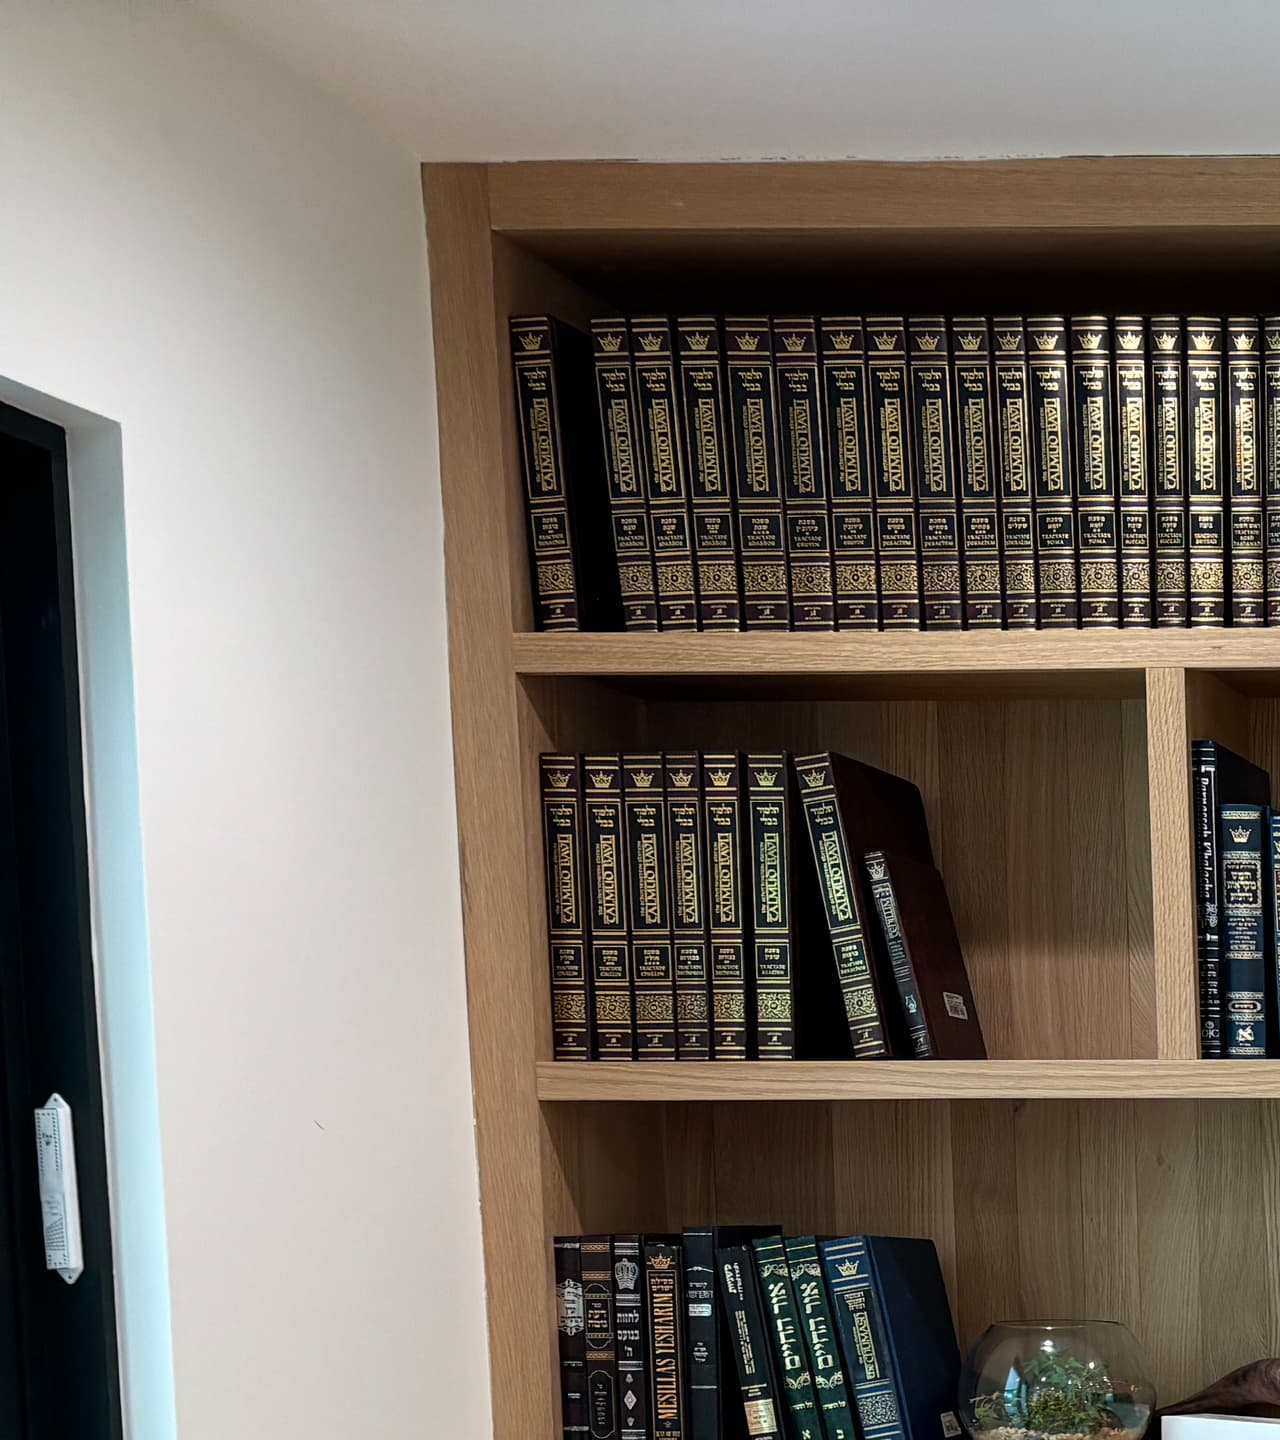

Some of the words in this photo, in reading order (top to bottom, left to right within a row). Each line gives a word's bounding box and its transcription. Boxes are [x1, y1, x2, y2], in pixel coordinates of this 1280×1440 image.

[653, 1293, 675, 1353] YESHARIM
[768, 1282, 790, 1314] אור
[777, 1318, 801, 1370] החיים
[656, 1358, 678, 1420] MESILLAS
